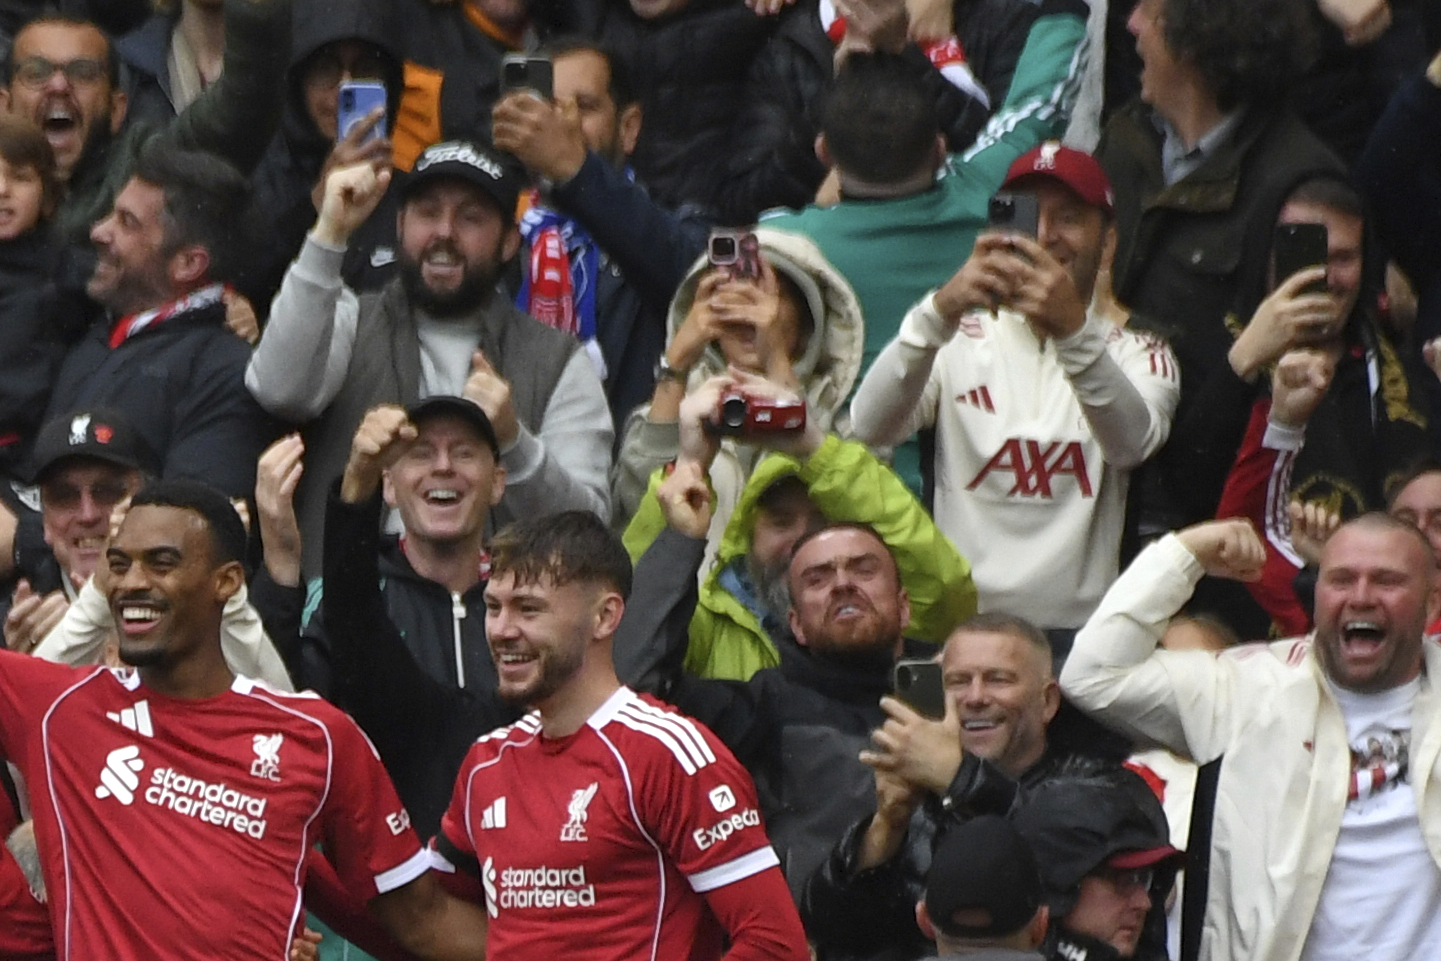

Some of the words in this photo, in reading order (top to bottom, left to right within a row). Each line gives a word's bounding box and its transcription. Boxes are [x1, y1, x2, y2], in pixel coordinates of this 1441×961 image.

[964, 438, 1093, 498] AXA
[145, 785, 267, 840] chartered
[150, 767, 267, 818] standard
[499, 865, 586, 888] standard
[499, 884, 596, 909] chartered
